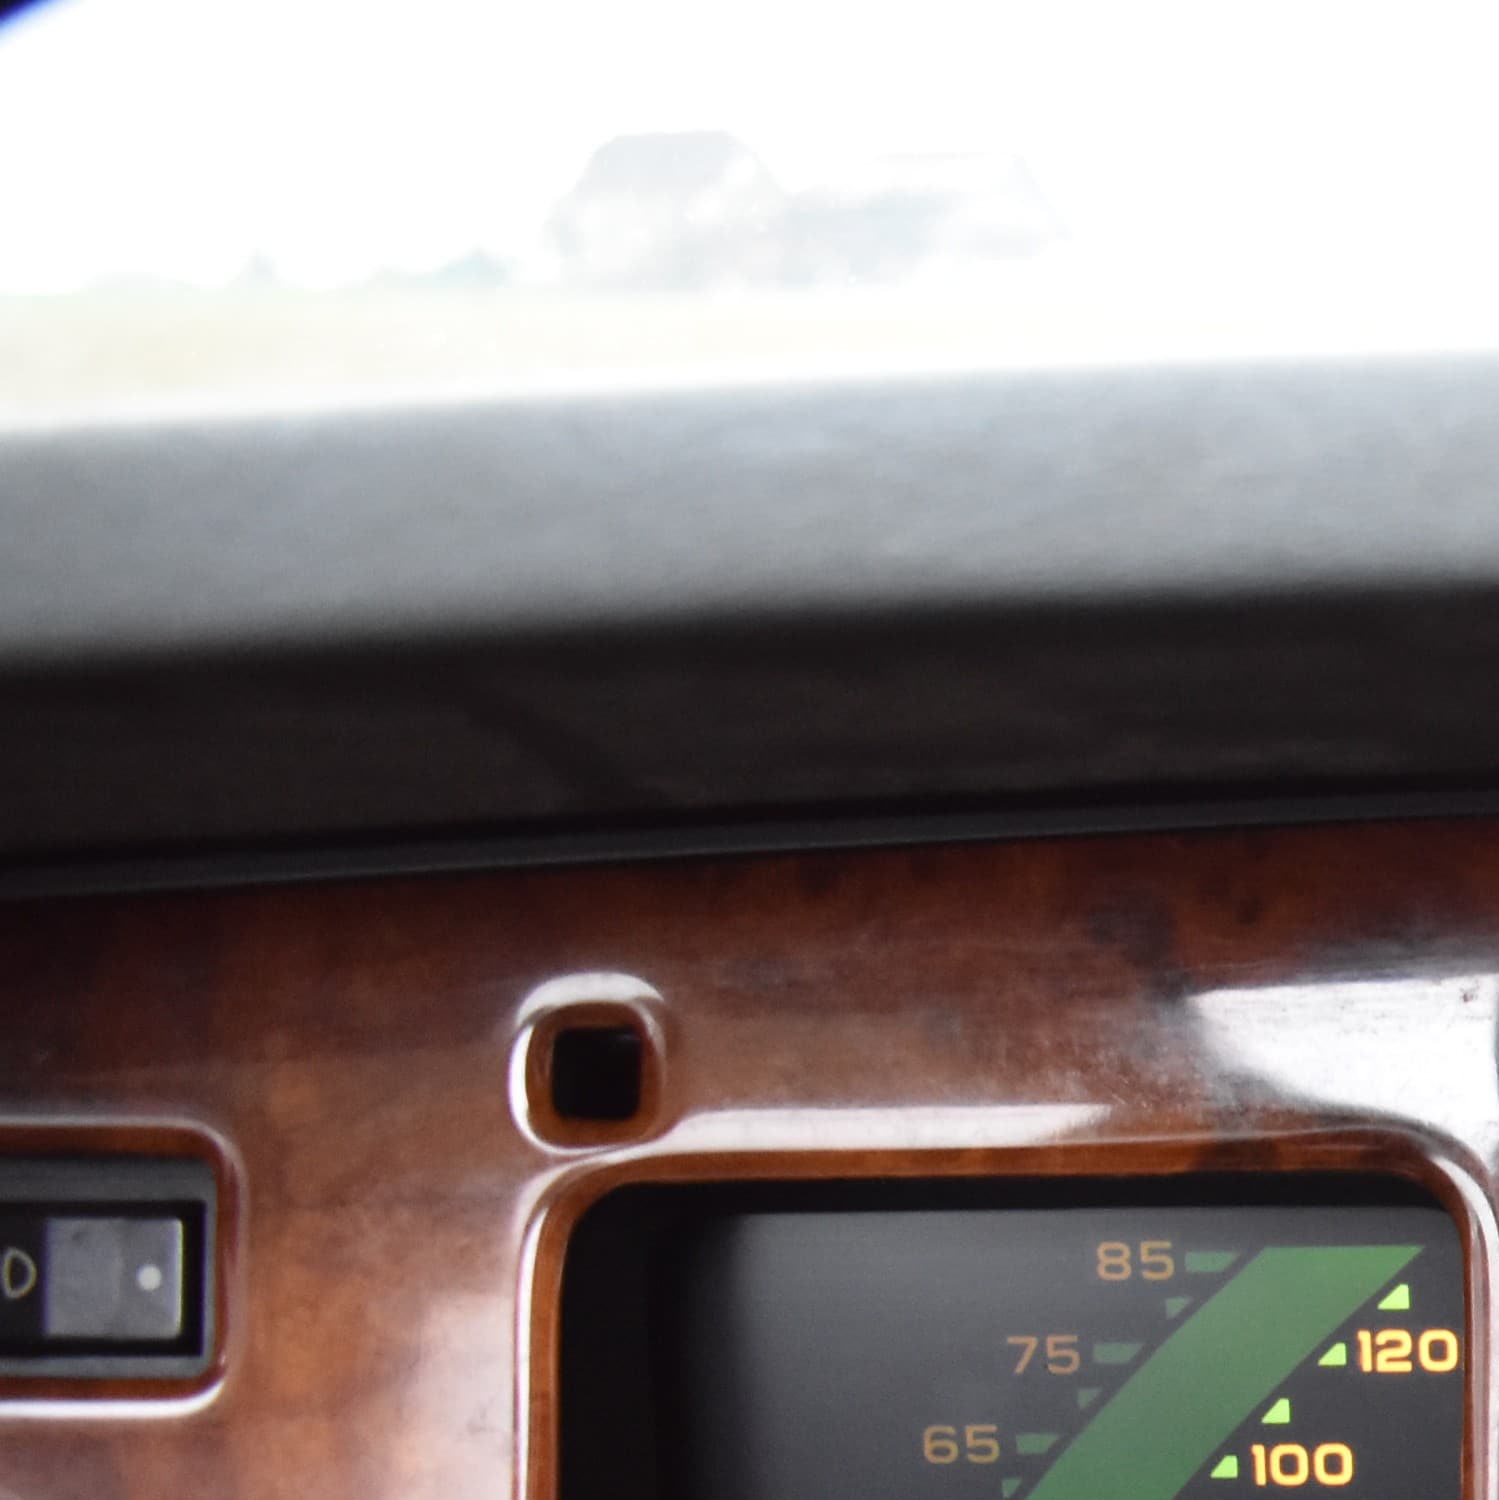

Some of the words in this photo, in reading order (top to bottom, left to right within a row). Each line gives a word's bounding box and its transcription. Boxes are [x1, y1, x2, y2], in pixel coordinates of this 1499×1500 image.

[1096, 1241, 1177, 1281] 85
[1007, 1336, 1083, 1375] 75
[1357, 1329, 1460, 1373] 120
[923, 1425, 1001, 1465] 65
[1250, 1443, 1354, 1487] 100
